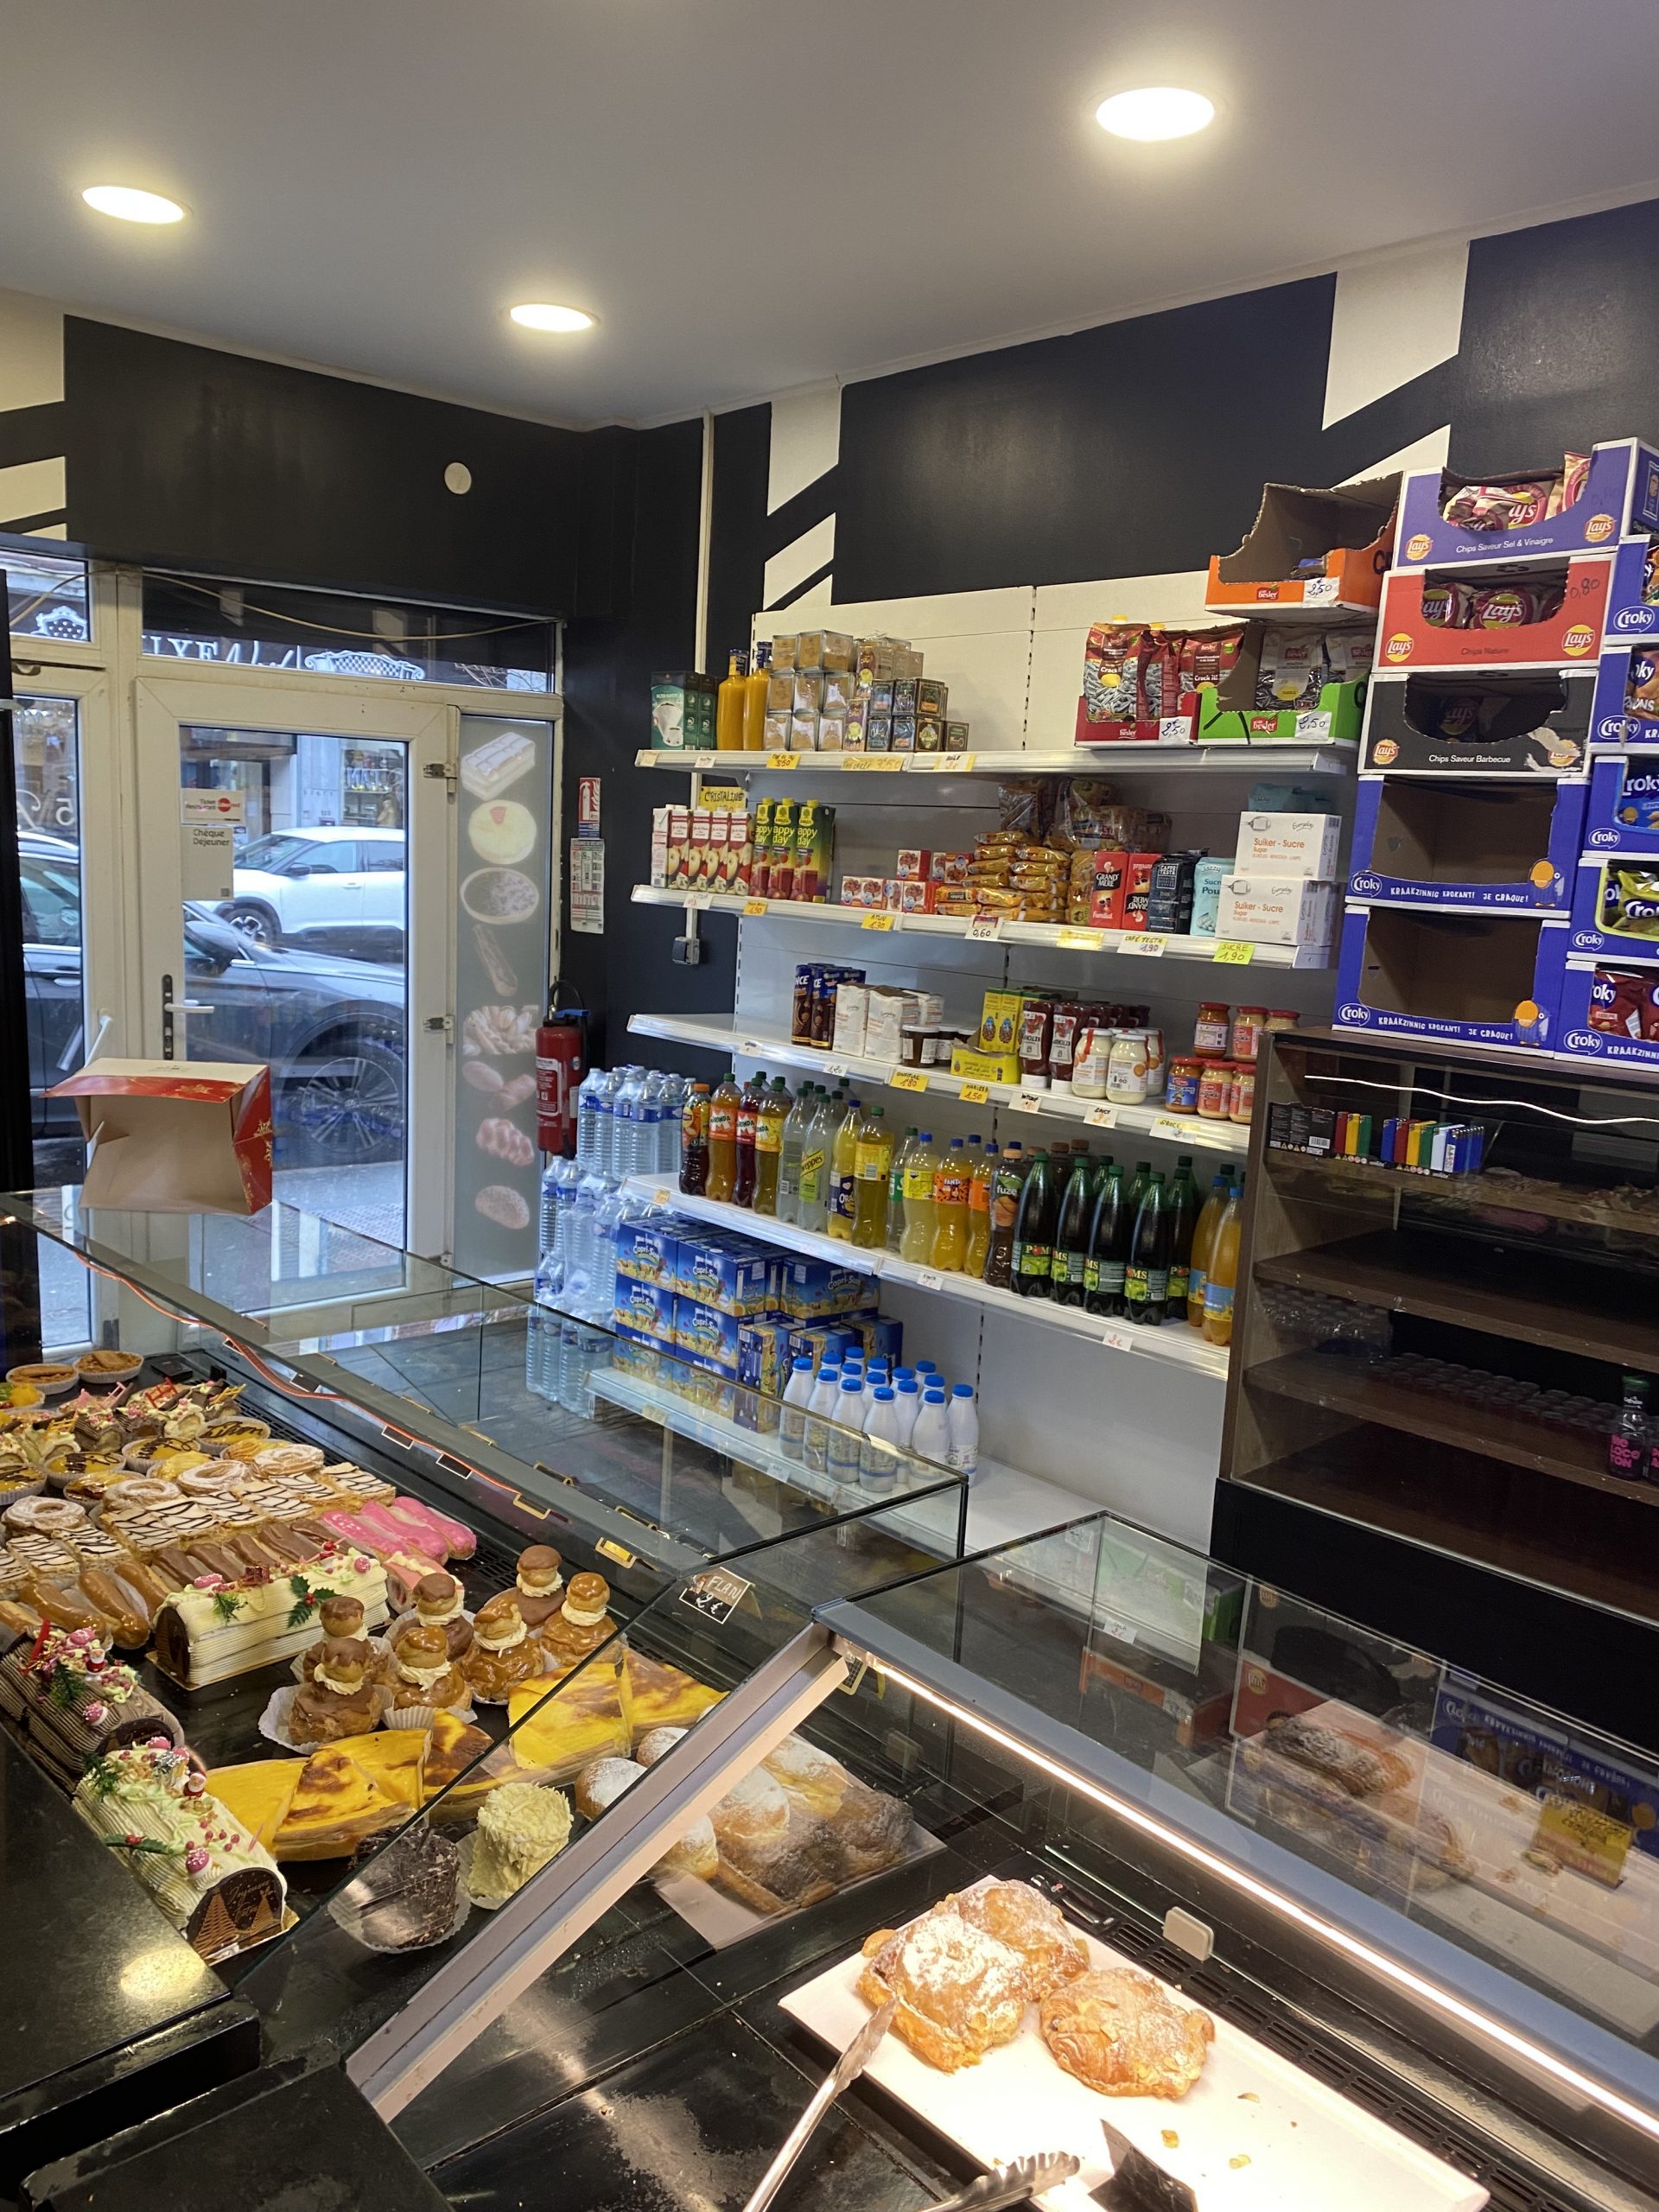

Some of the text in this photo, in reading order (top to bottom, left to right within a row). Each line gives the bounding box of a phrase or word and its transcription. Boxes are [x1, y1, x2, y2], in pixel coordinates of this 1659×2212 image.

[1456, 544, 1477, 554] Chips
[1478, 543, 1502, 551] Saveur
[1503, 540, 1516, 549] Sel
[1524, 537, 1554, 547] Vinaigre
[1570, 577, 1600, 599] 0,80
[1617, 609, 1653, 627] Croky
[1461, 646, 1510, 657] Chips Nature
[1428, 753, 1511, 764] Chips Saveur Barbecue
[1621, 774, 1659, 797] roky
[772, 833, 789, 847] day
[1254, 837, 1276, 847] Suiker
[1282, 839, 1306, 849] Sucre
[1591, 830, 1618, 844] Croky
[1353, 876, 1381, 892] Croky
[1390, 887, 1440, 899] KRAAKZINNIG
[1442, 890, 1475, 899] KROKANT!
[1495, 893, 1529, 903] CRAQUE!
[1234, 900, 1256, 911] Suiker
[1262, 903, 1284, 913] Sucre
[972, 928, 991, 938] 0,60
[1575, 933, 1603, 947] Croky
[1218, 950, 1245, 962] 1,90
[1340, 1005, 1369, 1021] Croky
[1378, 1016, 1426, 1030] KRAAKZINNIG
[1428, 1022, 1461, 1033] KROKANT!
[1480, 1029, 1513, 1040] CRAQUE!
[1567, 1032, 1601, 1049] Croky
[996, 1185, 1018, 1196] fuze
[692, 1266, 720, 1284] Capri-Sun
[827, 1274, 861, 1291] Capri-Sun
[692, 1318, 720, 1336] Capri-Sun
[707, 1575, 741, 1599] FLAN
